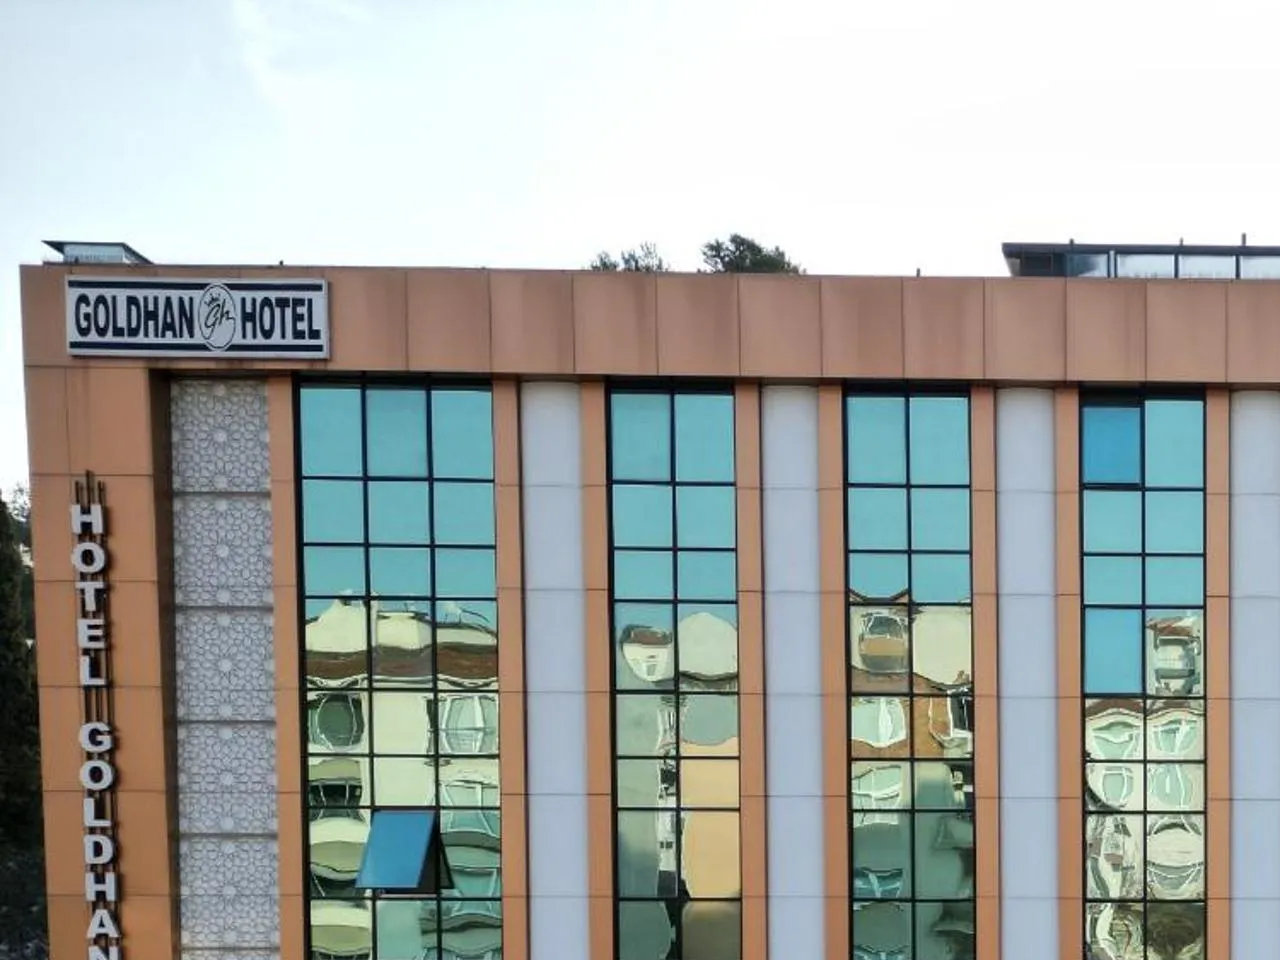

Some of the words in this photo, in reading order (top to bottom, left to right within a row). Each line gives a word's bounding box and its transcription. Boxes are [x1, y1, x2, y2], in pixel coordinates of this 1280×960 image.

[74, 293, 196, 339] GOLDHAN
[241, 297, 322, 341] HOTEL
[70, 502, 106, 687] HOTEL
